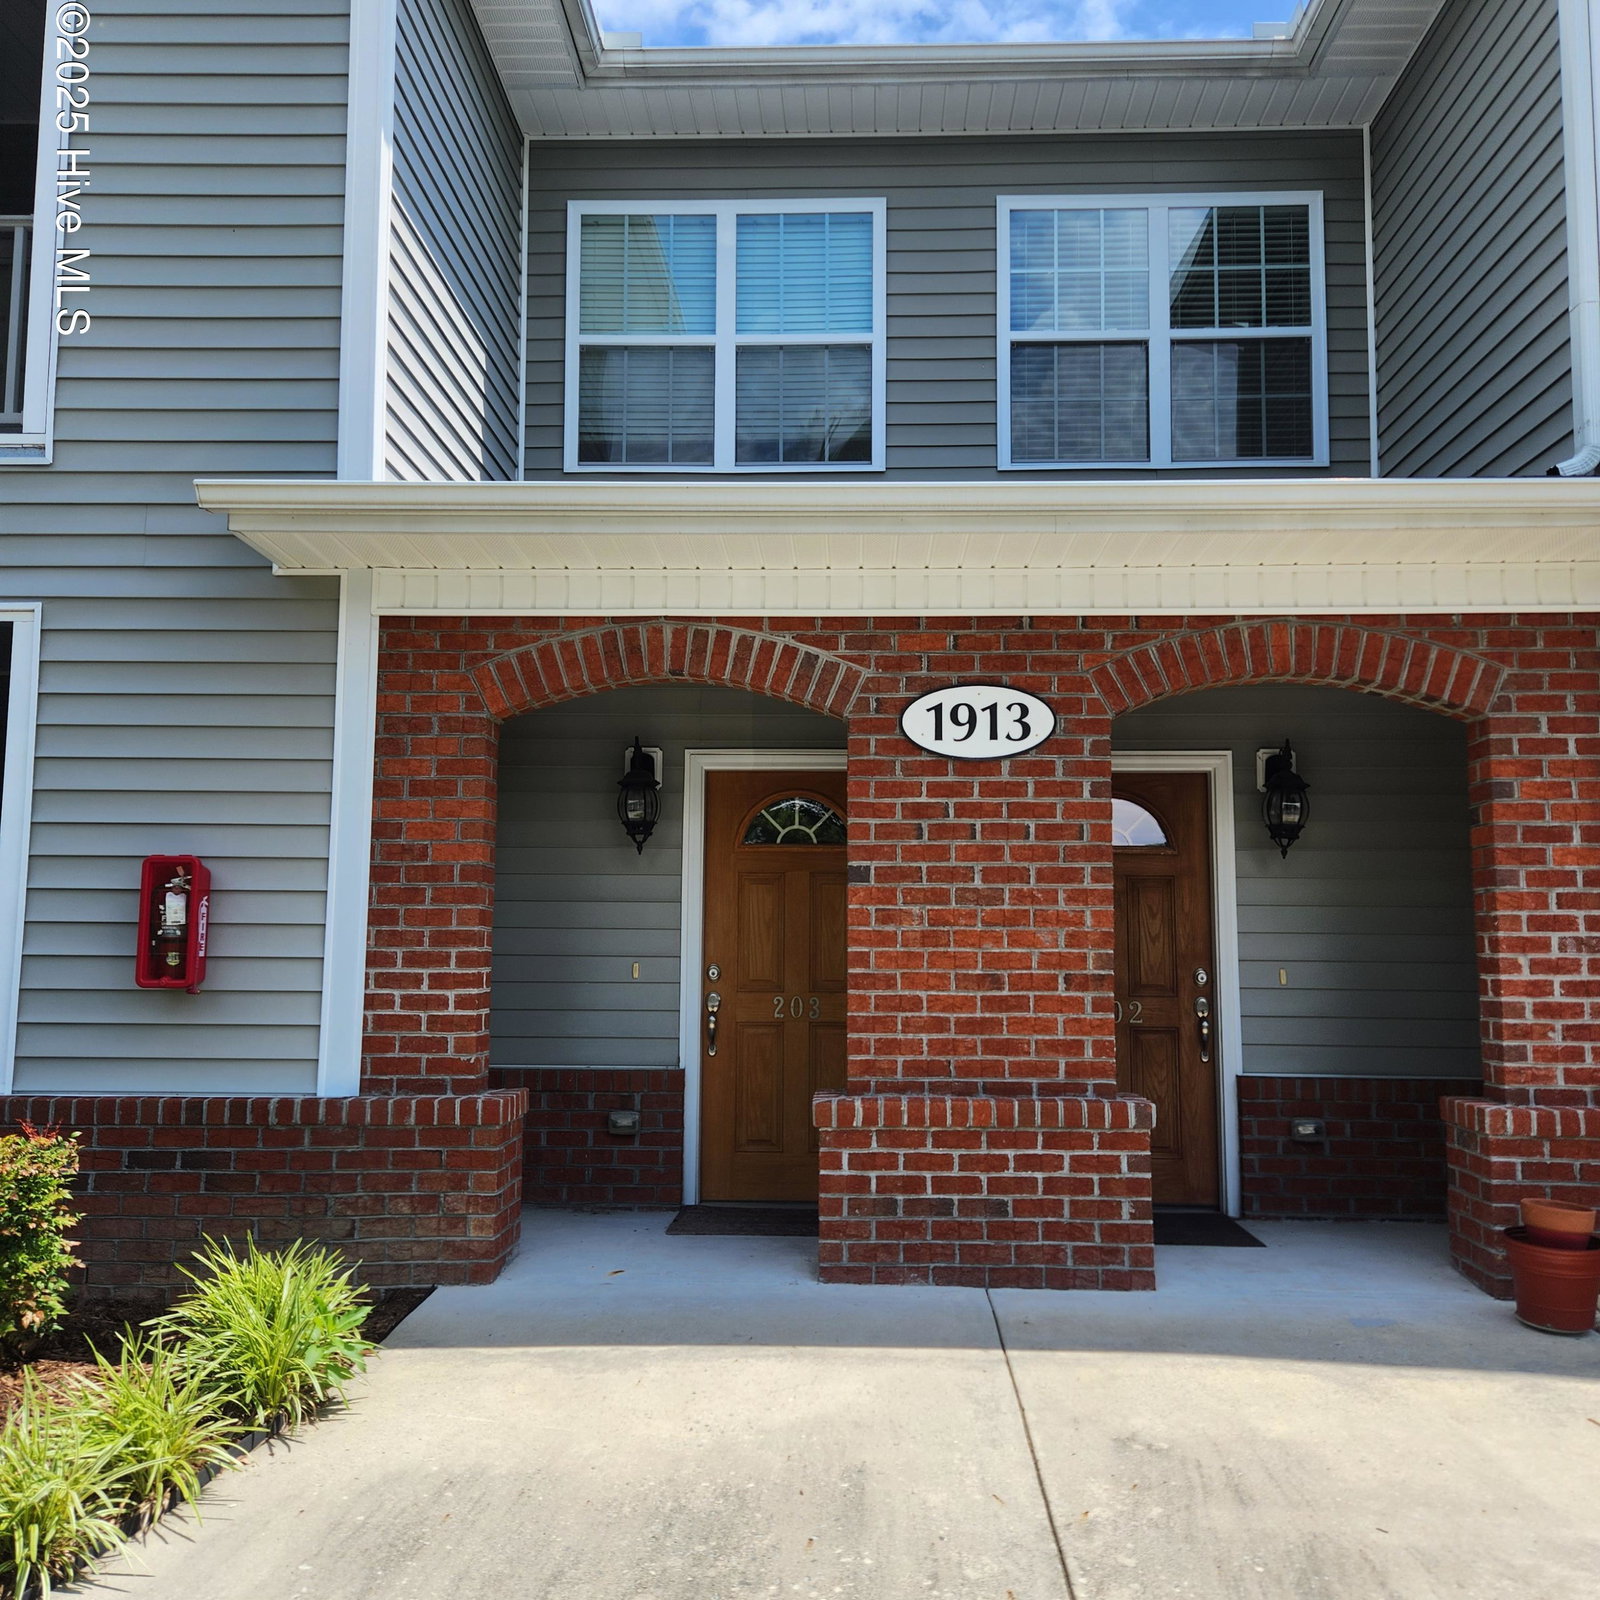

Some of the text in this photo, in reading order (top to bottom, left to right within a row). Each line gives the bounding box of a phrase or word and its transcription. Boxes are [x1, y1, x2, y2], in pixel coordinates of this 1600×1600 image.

[926, 702, 1031, 742] 1913
[773, 995, 820, 1018] 203
[1113, 1000, 1143, 1024] 02
